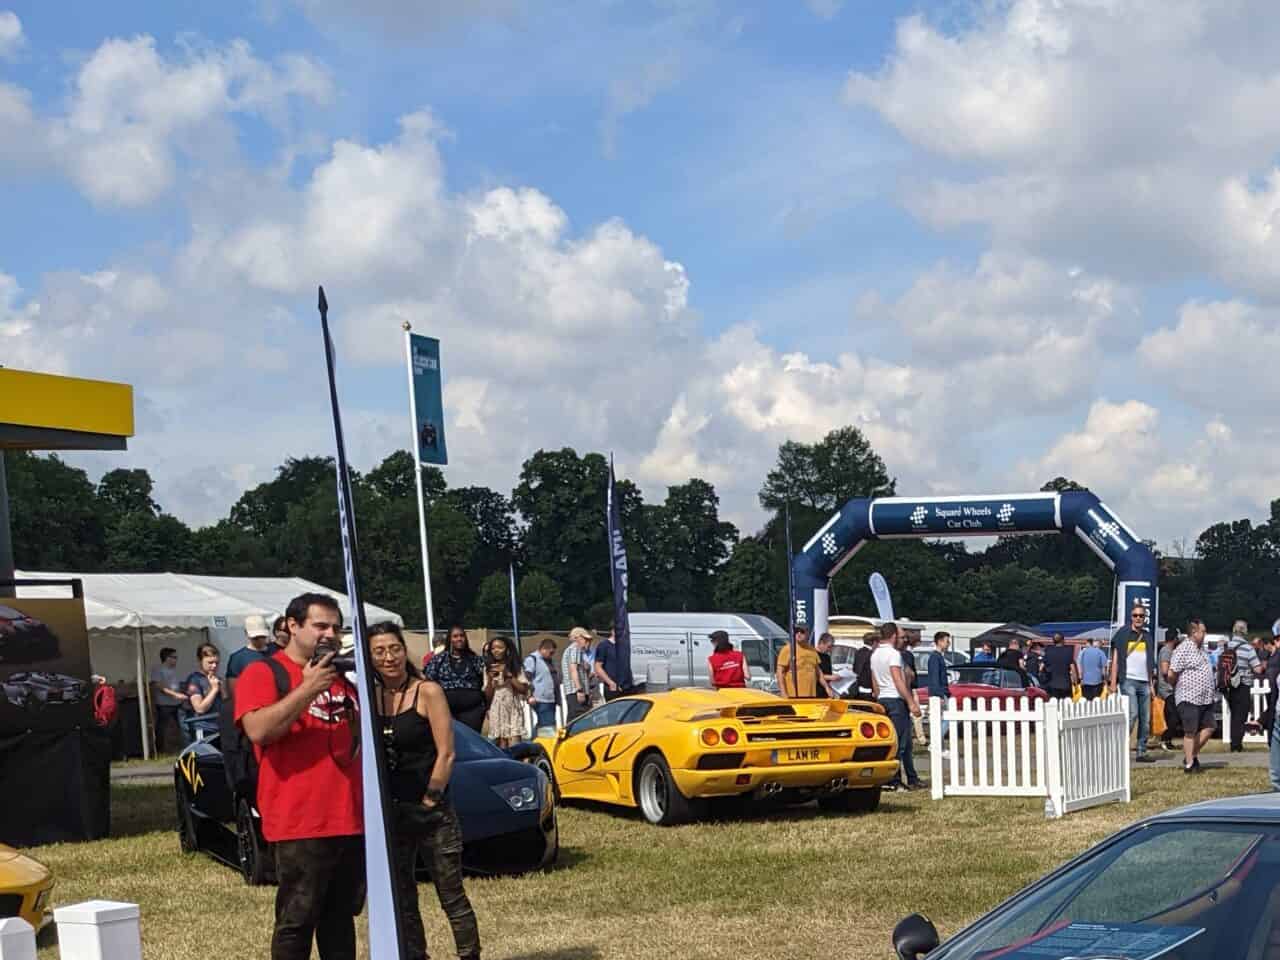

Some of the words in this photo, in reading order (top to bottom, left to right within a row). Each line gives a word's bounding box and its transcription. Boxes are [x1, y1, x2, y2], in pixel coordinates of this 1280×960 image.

[936, 504, 962, 519] Square
[964, 505, 991, 517] Wheels
[947, 519, 961, 529] Car
[962, 519, 982, 528] Club
[788, 751, 808, 761] LAM
